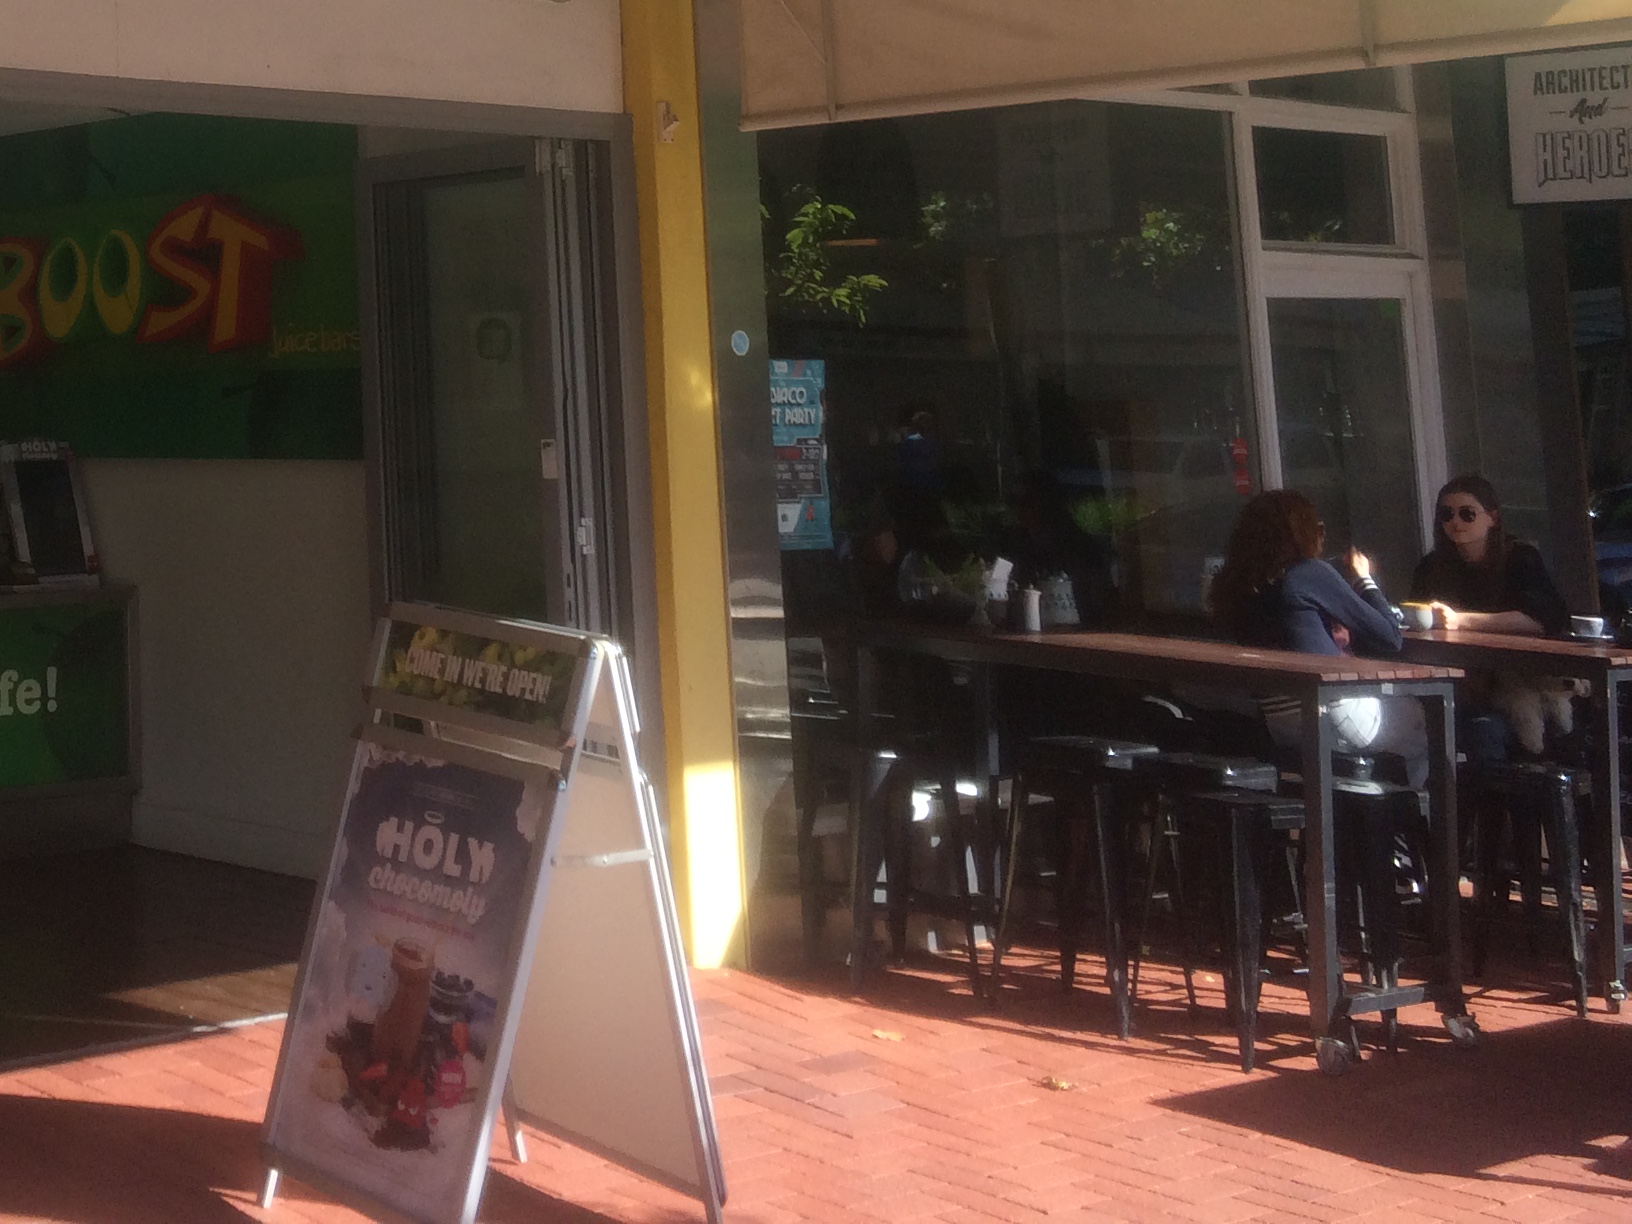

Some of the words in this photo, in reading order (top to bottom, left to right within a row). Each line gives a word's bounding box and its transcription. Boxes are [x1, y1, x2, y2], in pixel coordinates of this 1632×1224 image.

[1534, 127, 1632, 188] HEROE
[405, 646, 446, 680] COME
[443, 655, 463, 684] IN
[463, 658, 508, 694] WE'RE
[506, 668, 553, 704] OPEN!
[375, 815, 496, 885] HOLY
